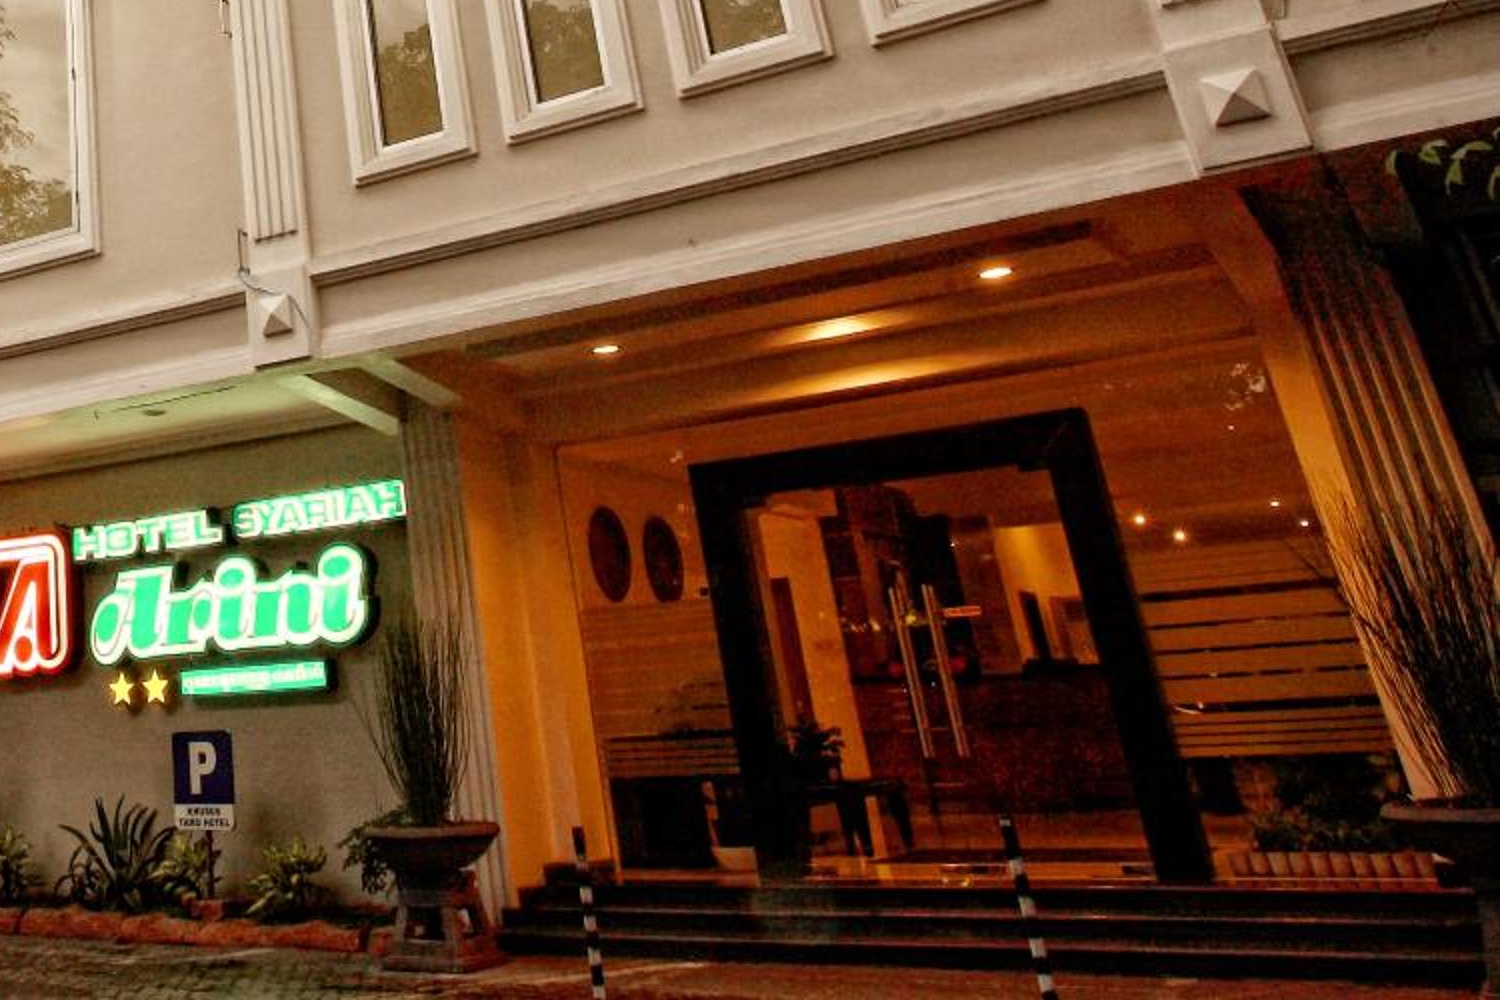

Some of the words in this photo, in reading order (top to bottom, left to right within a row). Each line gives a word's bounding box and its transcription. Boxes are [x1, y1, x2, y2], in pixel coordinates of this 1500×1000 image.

[72, 509, 223, 561] HOTEL
[232, 480, 406, 538] SYARIAH
[91, 543, 368, 666] Arini
[188, 741, 217, 795] P
